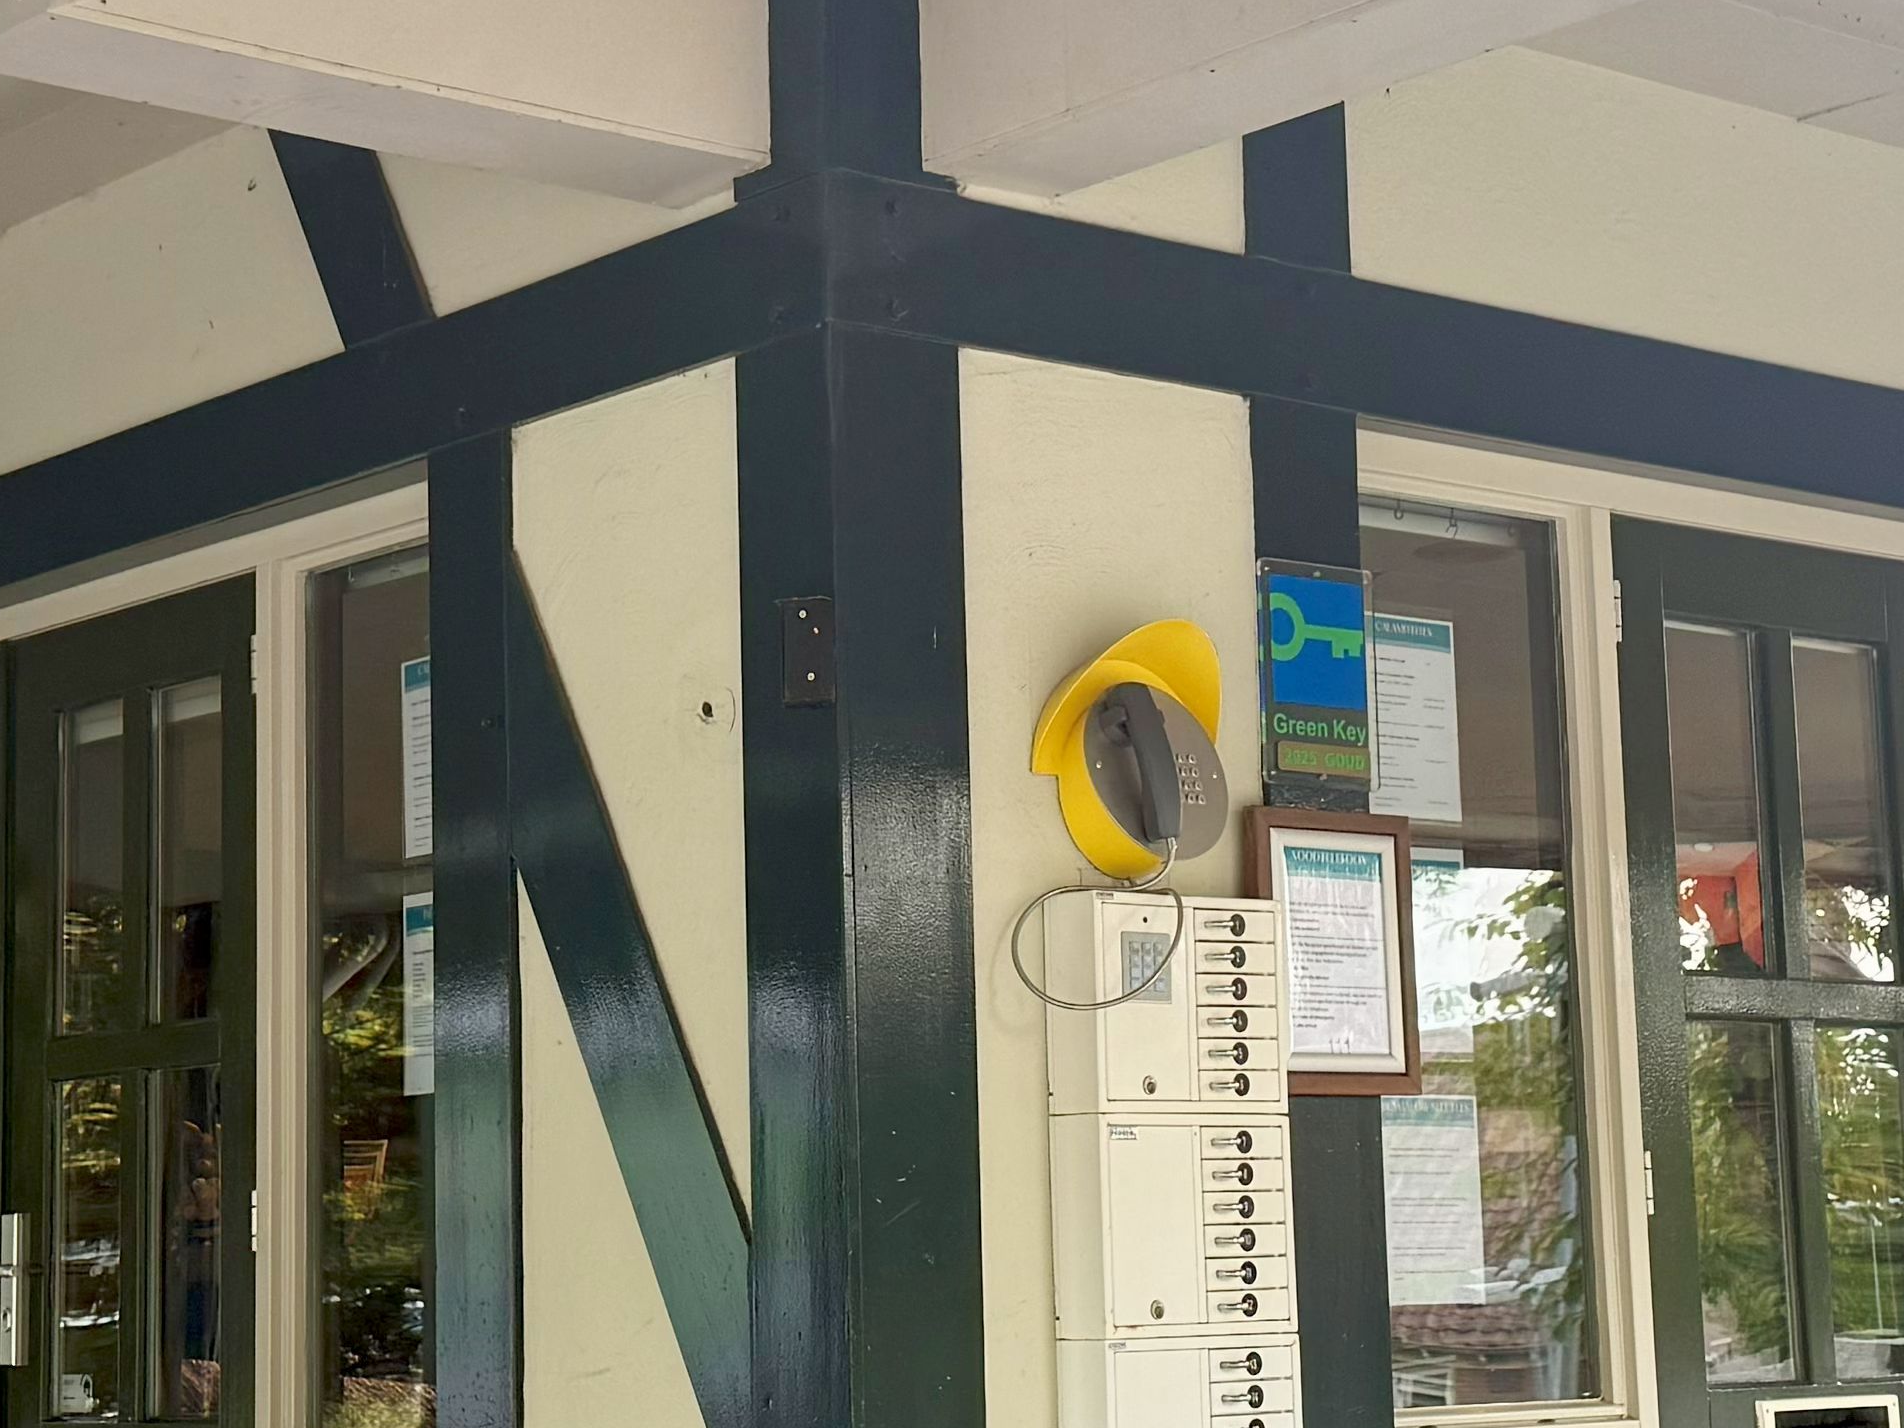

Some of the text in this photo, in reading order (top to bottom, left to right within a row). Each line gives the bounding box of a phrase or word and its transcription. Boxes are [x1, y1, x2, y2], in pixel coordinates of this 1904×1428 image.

[1273, 712, 1366, 746] Green Key
[1325, 752, 1365, 771] GOUD
